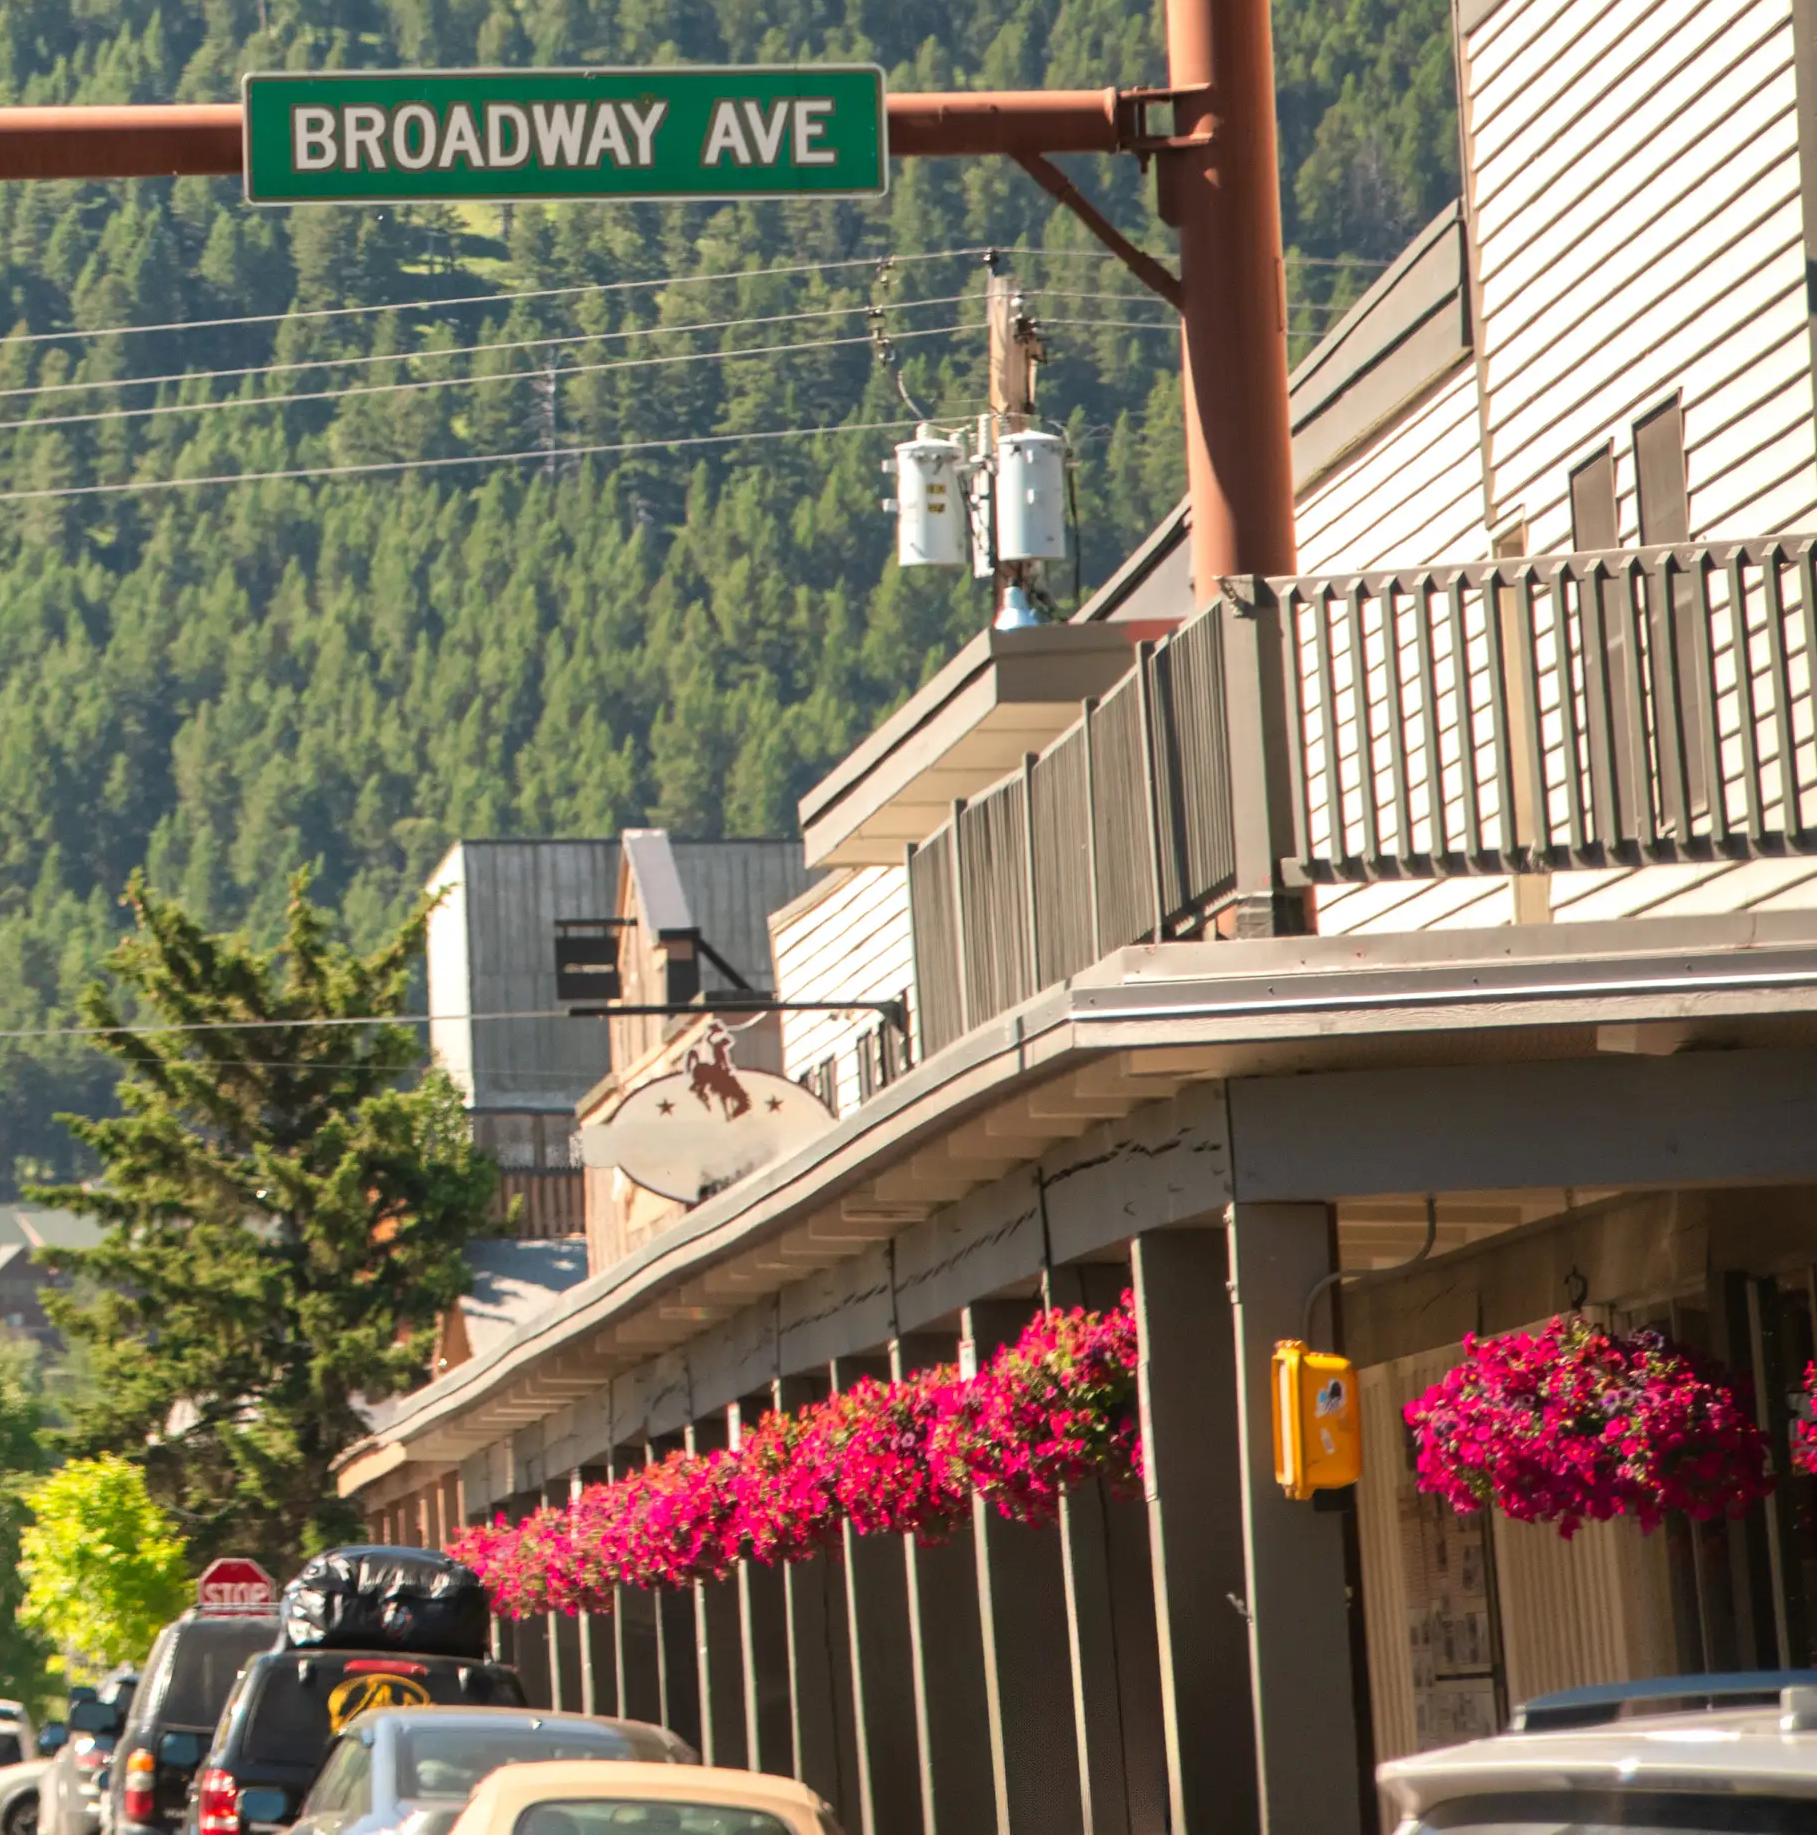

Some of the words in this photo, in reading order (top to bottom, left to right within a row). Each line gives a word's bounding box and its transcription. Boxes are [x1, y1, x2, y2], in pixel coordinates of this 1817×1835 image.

[293, 102, 667, 169] BROADWAY
[703, 100, 836, 165] AVE
[205, 1582, 269, 1609] STOP
